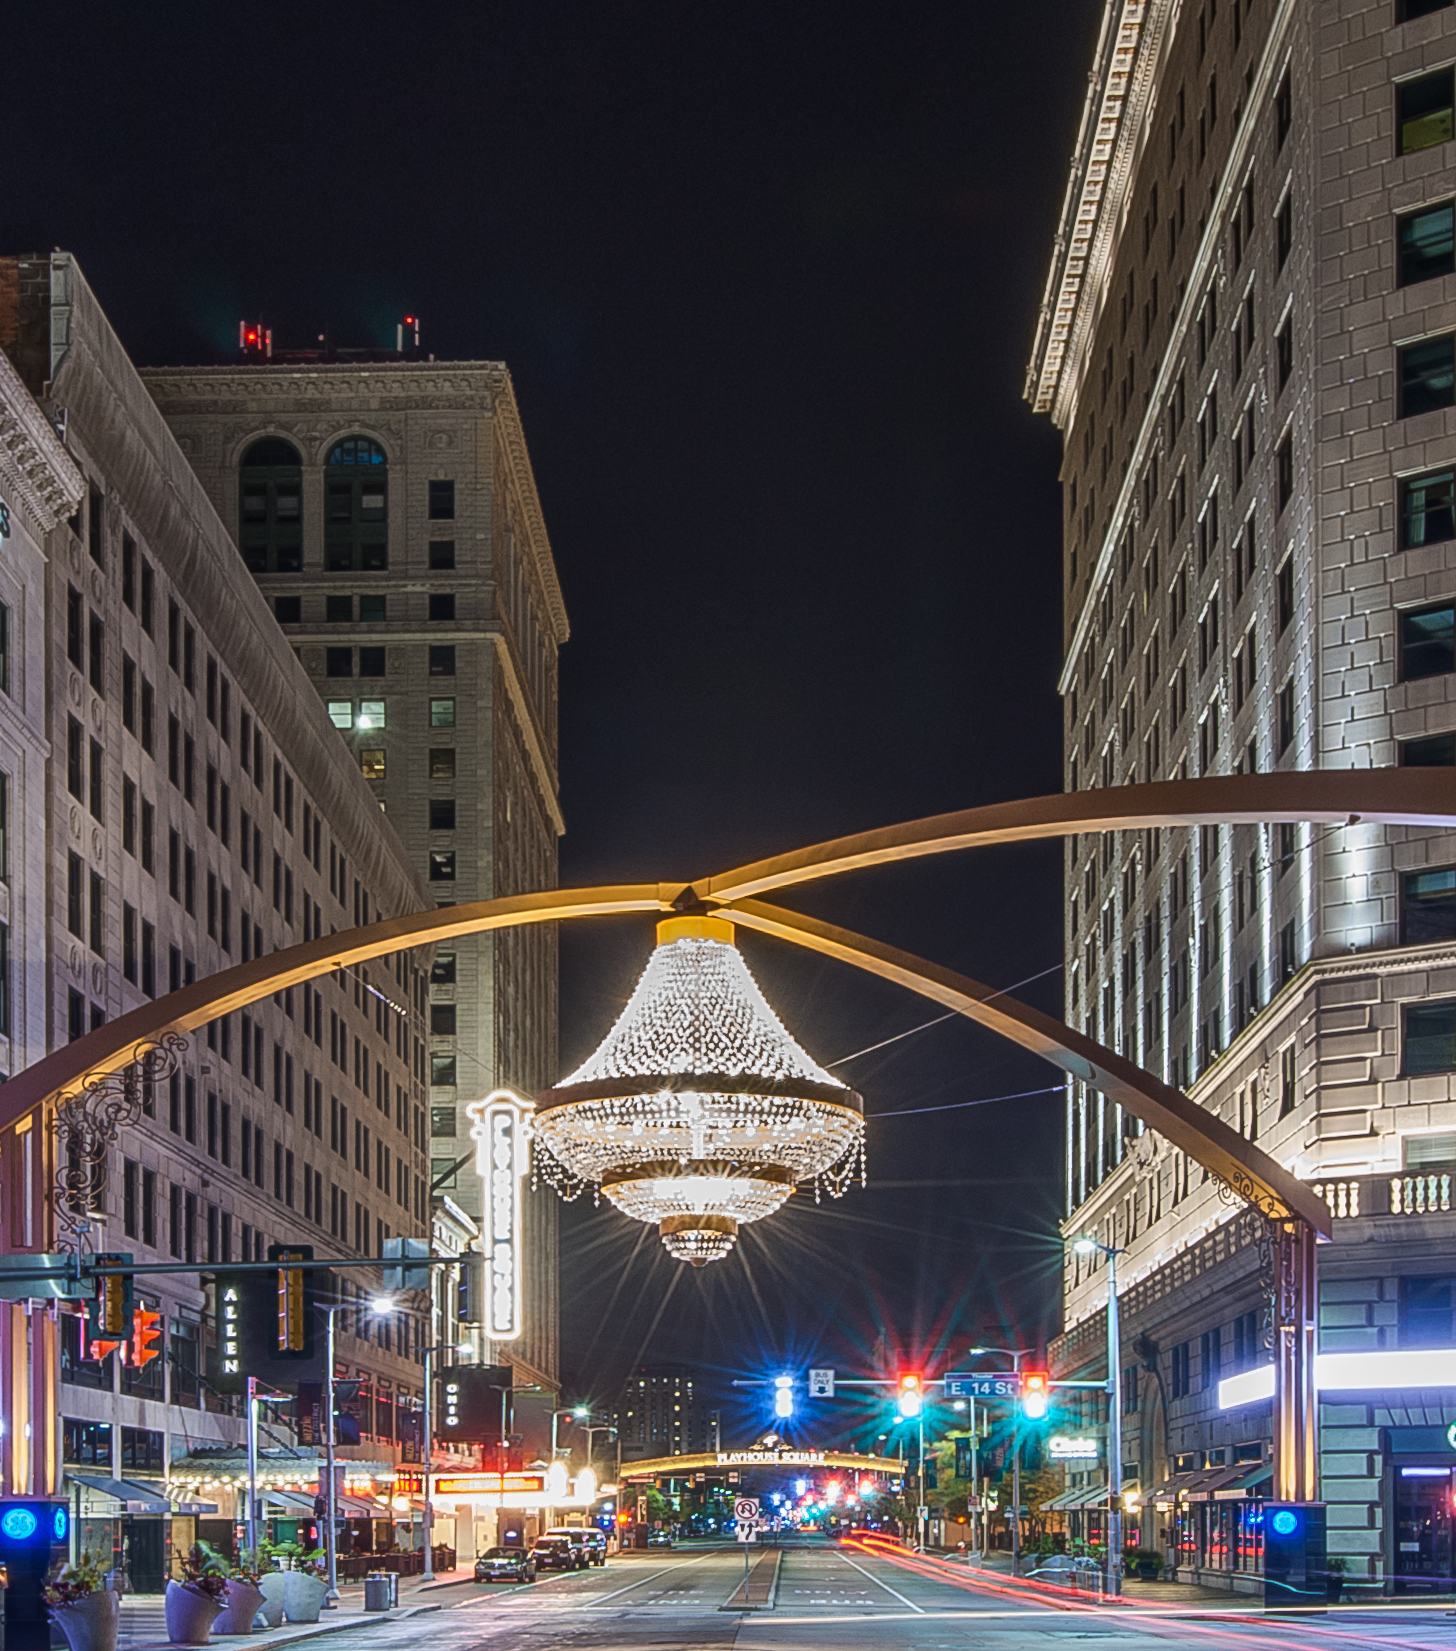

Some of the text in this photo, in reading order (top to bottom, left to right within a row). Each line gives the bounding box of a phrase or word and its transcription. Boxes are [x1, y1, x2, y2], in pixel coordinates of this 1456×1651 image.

[223, 1287, 239, 1374] ALLEN
[814, 1371, 829, 1379] BUS
[813, 1378, 831, 1386] ONLY
[951, 1381, 1014, 1395] E. 14 St
[446, 1384, 459, 1426] OHIO
[717, 1452, 825, 1463] PLAYHOUSE SQUARE
